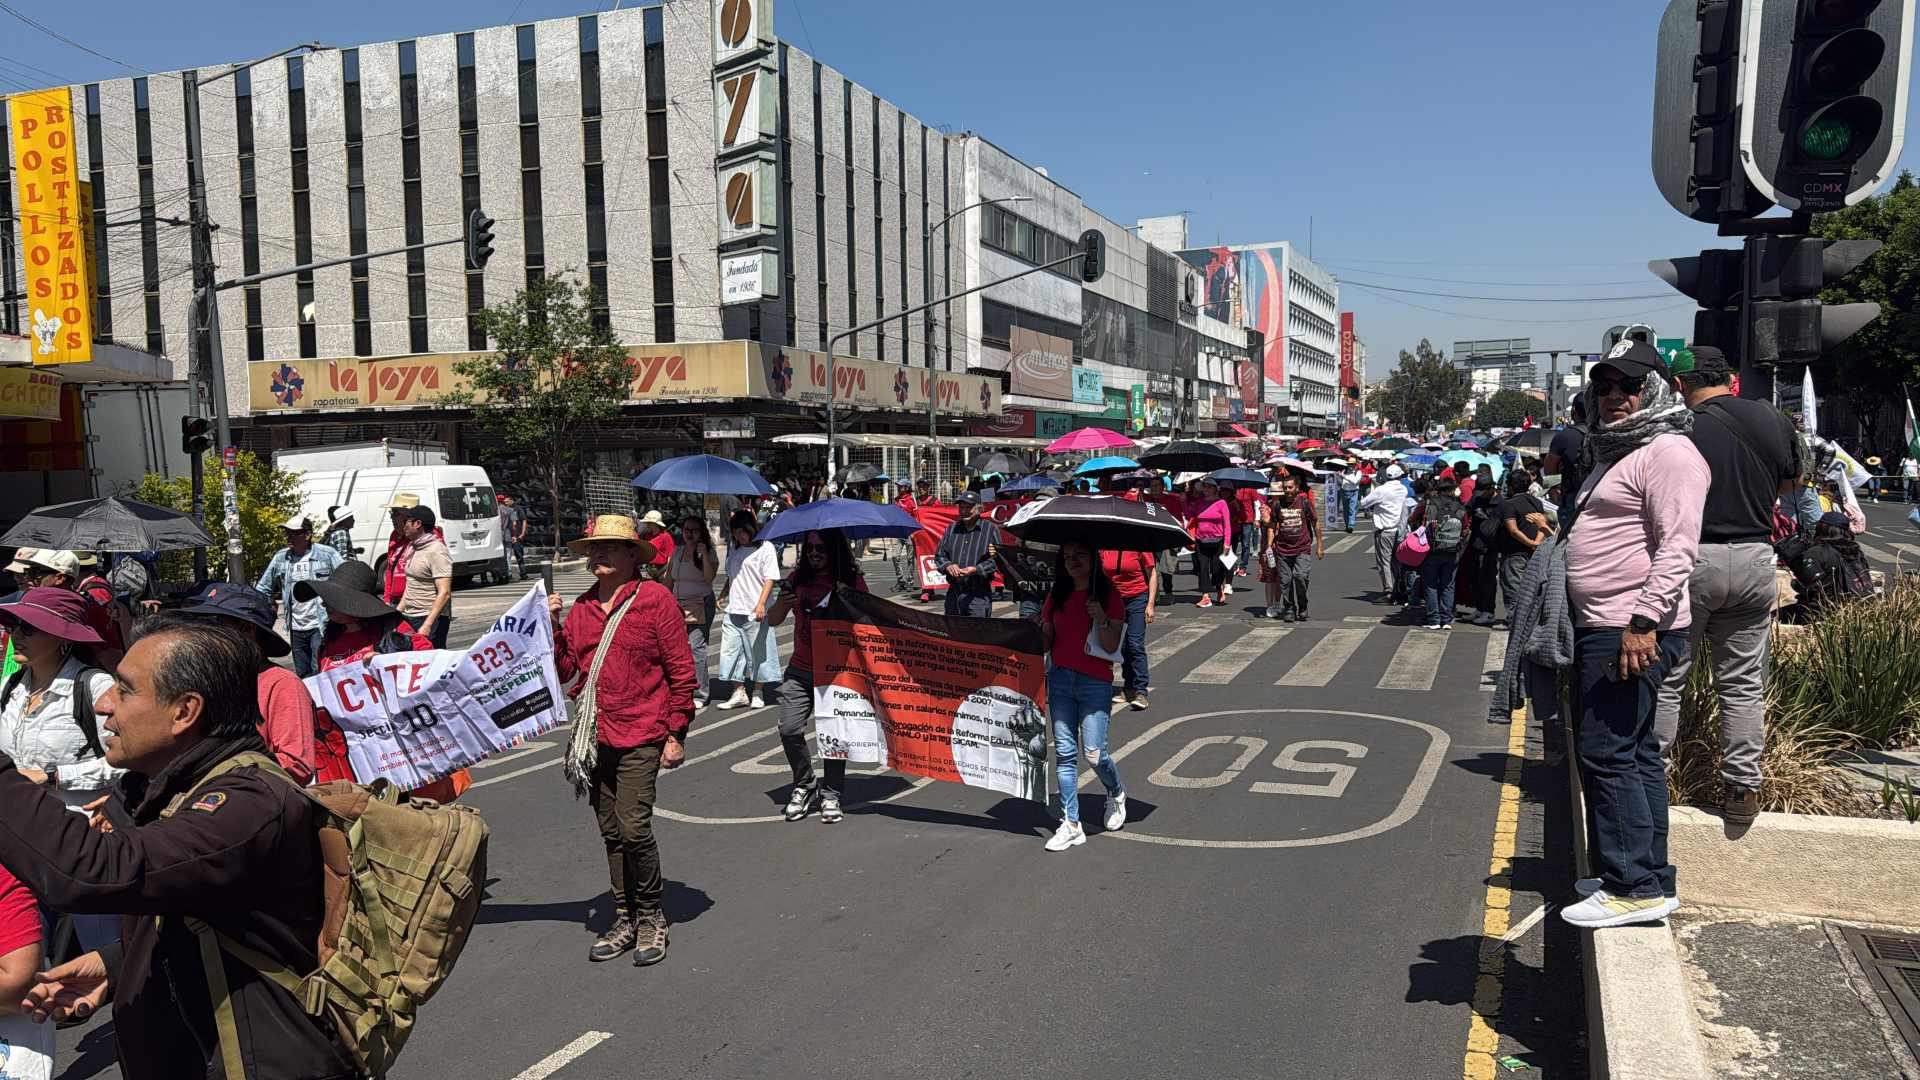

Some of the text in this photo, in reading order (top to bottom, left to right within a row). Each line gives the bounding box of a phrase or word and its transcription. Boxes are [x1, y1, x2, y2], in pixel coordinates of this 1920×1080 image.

[1803, 183, 1842, 193] CDMX
[20, 118, 52, 298] POLLOS
[44, 105, 82, 350] ROSTIZADOS
[329, 357, 440, 404] la joya
[471, 640, 515, 675] 223
[869, 644, 885, 656] que
[336, 662, 431, 713] CNTE
[488, 665, 544, 699] VESPERTINO
[898, 673, 912, 682] del
[832, 689, 859, 701] Pagos
[903, 702, 915, 711] en
[915, 704, 947, 715] salarios
[983, 717, 993, 725] no
[995, 719, 1005, 728] en
[935, 725, 945, 734] de
[955, 728, 990, 742] Reforma
[980, 765, 988, 773] SE
